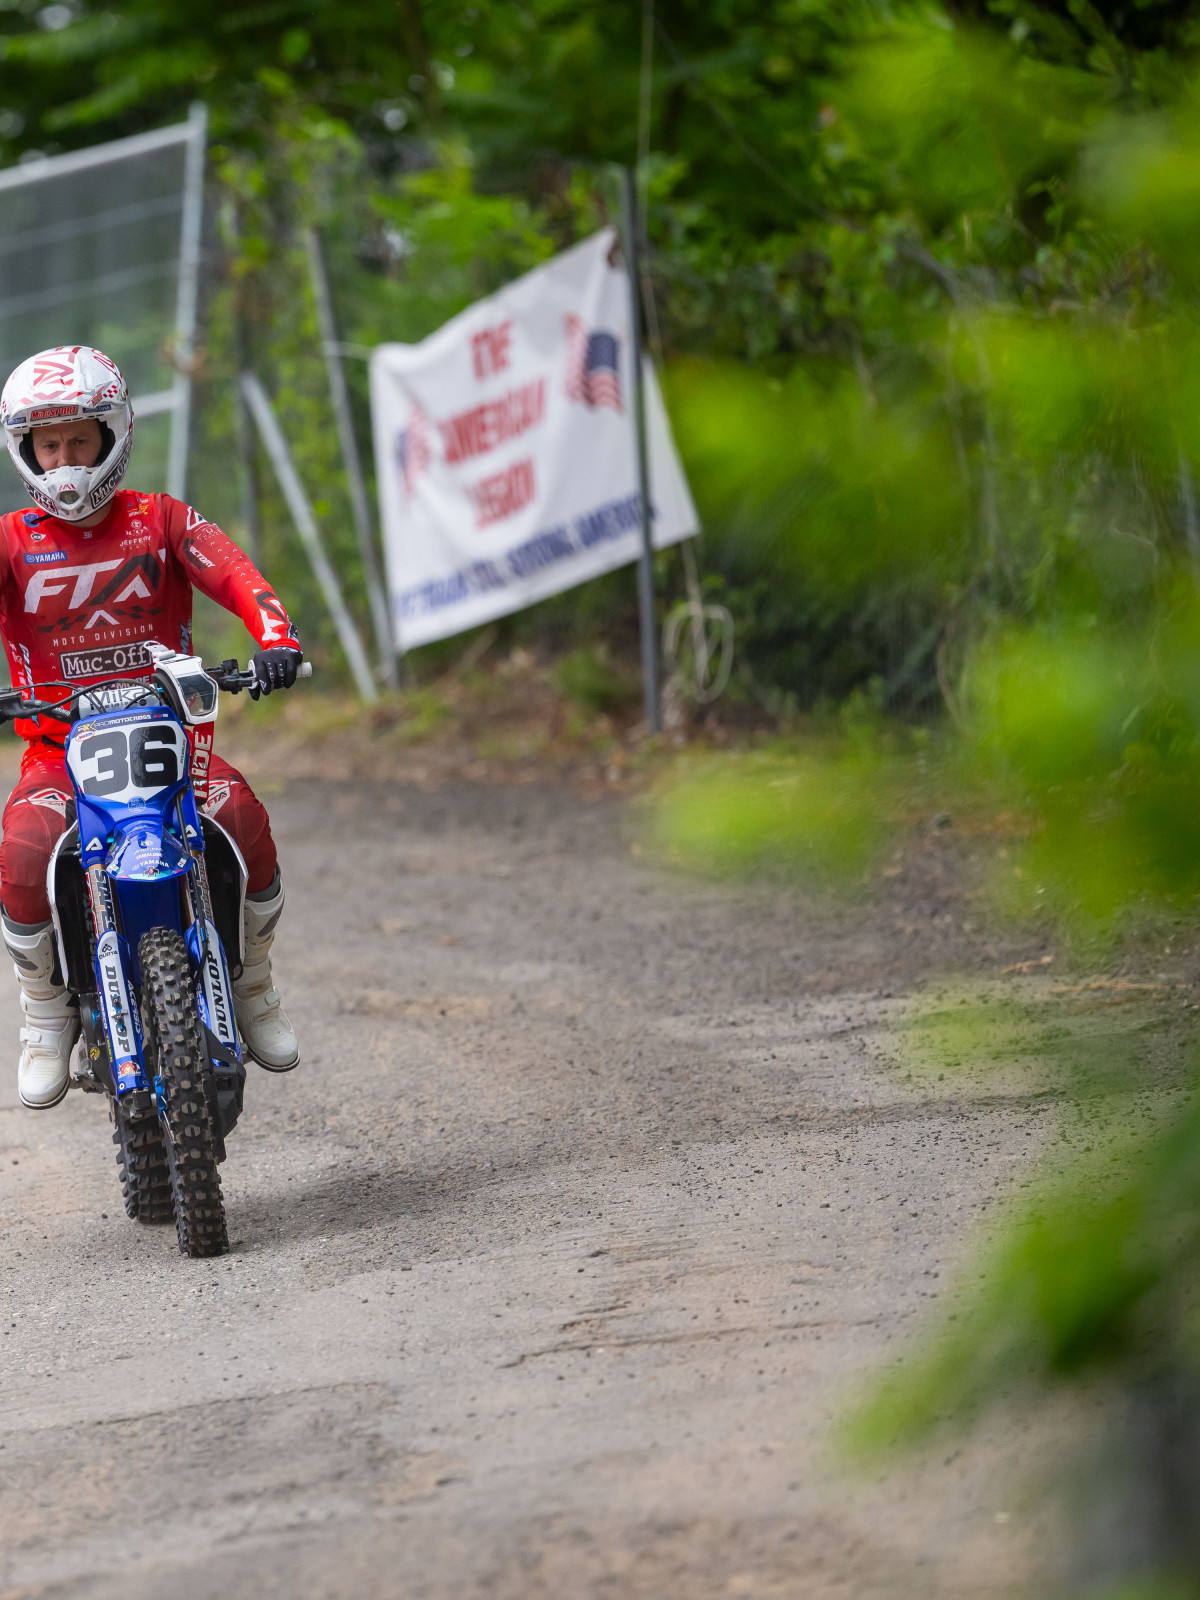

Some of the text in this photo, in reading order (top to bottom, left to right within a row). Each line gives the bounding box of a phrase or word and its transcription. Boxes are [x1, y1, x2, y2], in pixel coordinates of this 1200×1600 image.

[120, 536, 151, 547] JEFFERY
[35, 551, 65, 563] YAMAHA
[53, 624, 153, 647] MOTO DIVISION
[65, 642, 149, 676] Muc-Off
[79, 724, 179, 797] 36
[140, 859, 170, 868] YAMAHA
[105, 965, 131, 1053] DUOP
[207, 950, 230, 1040] DUNLOP
